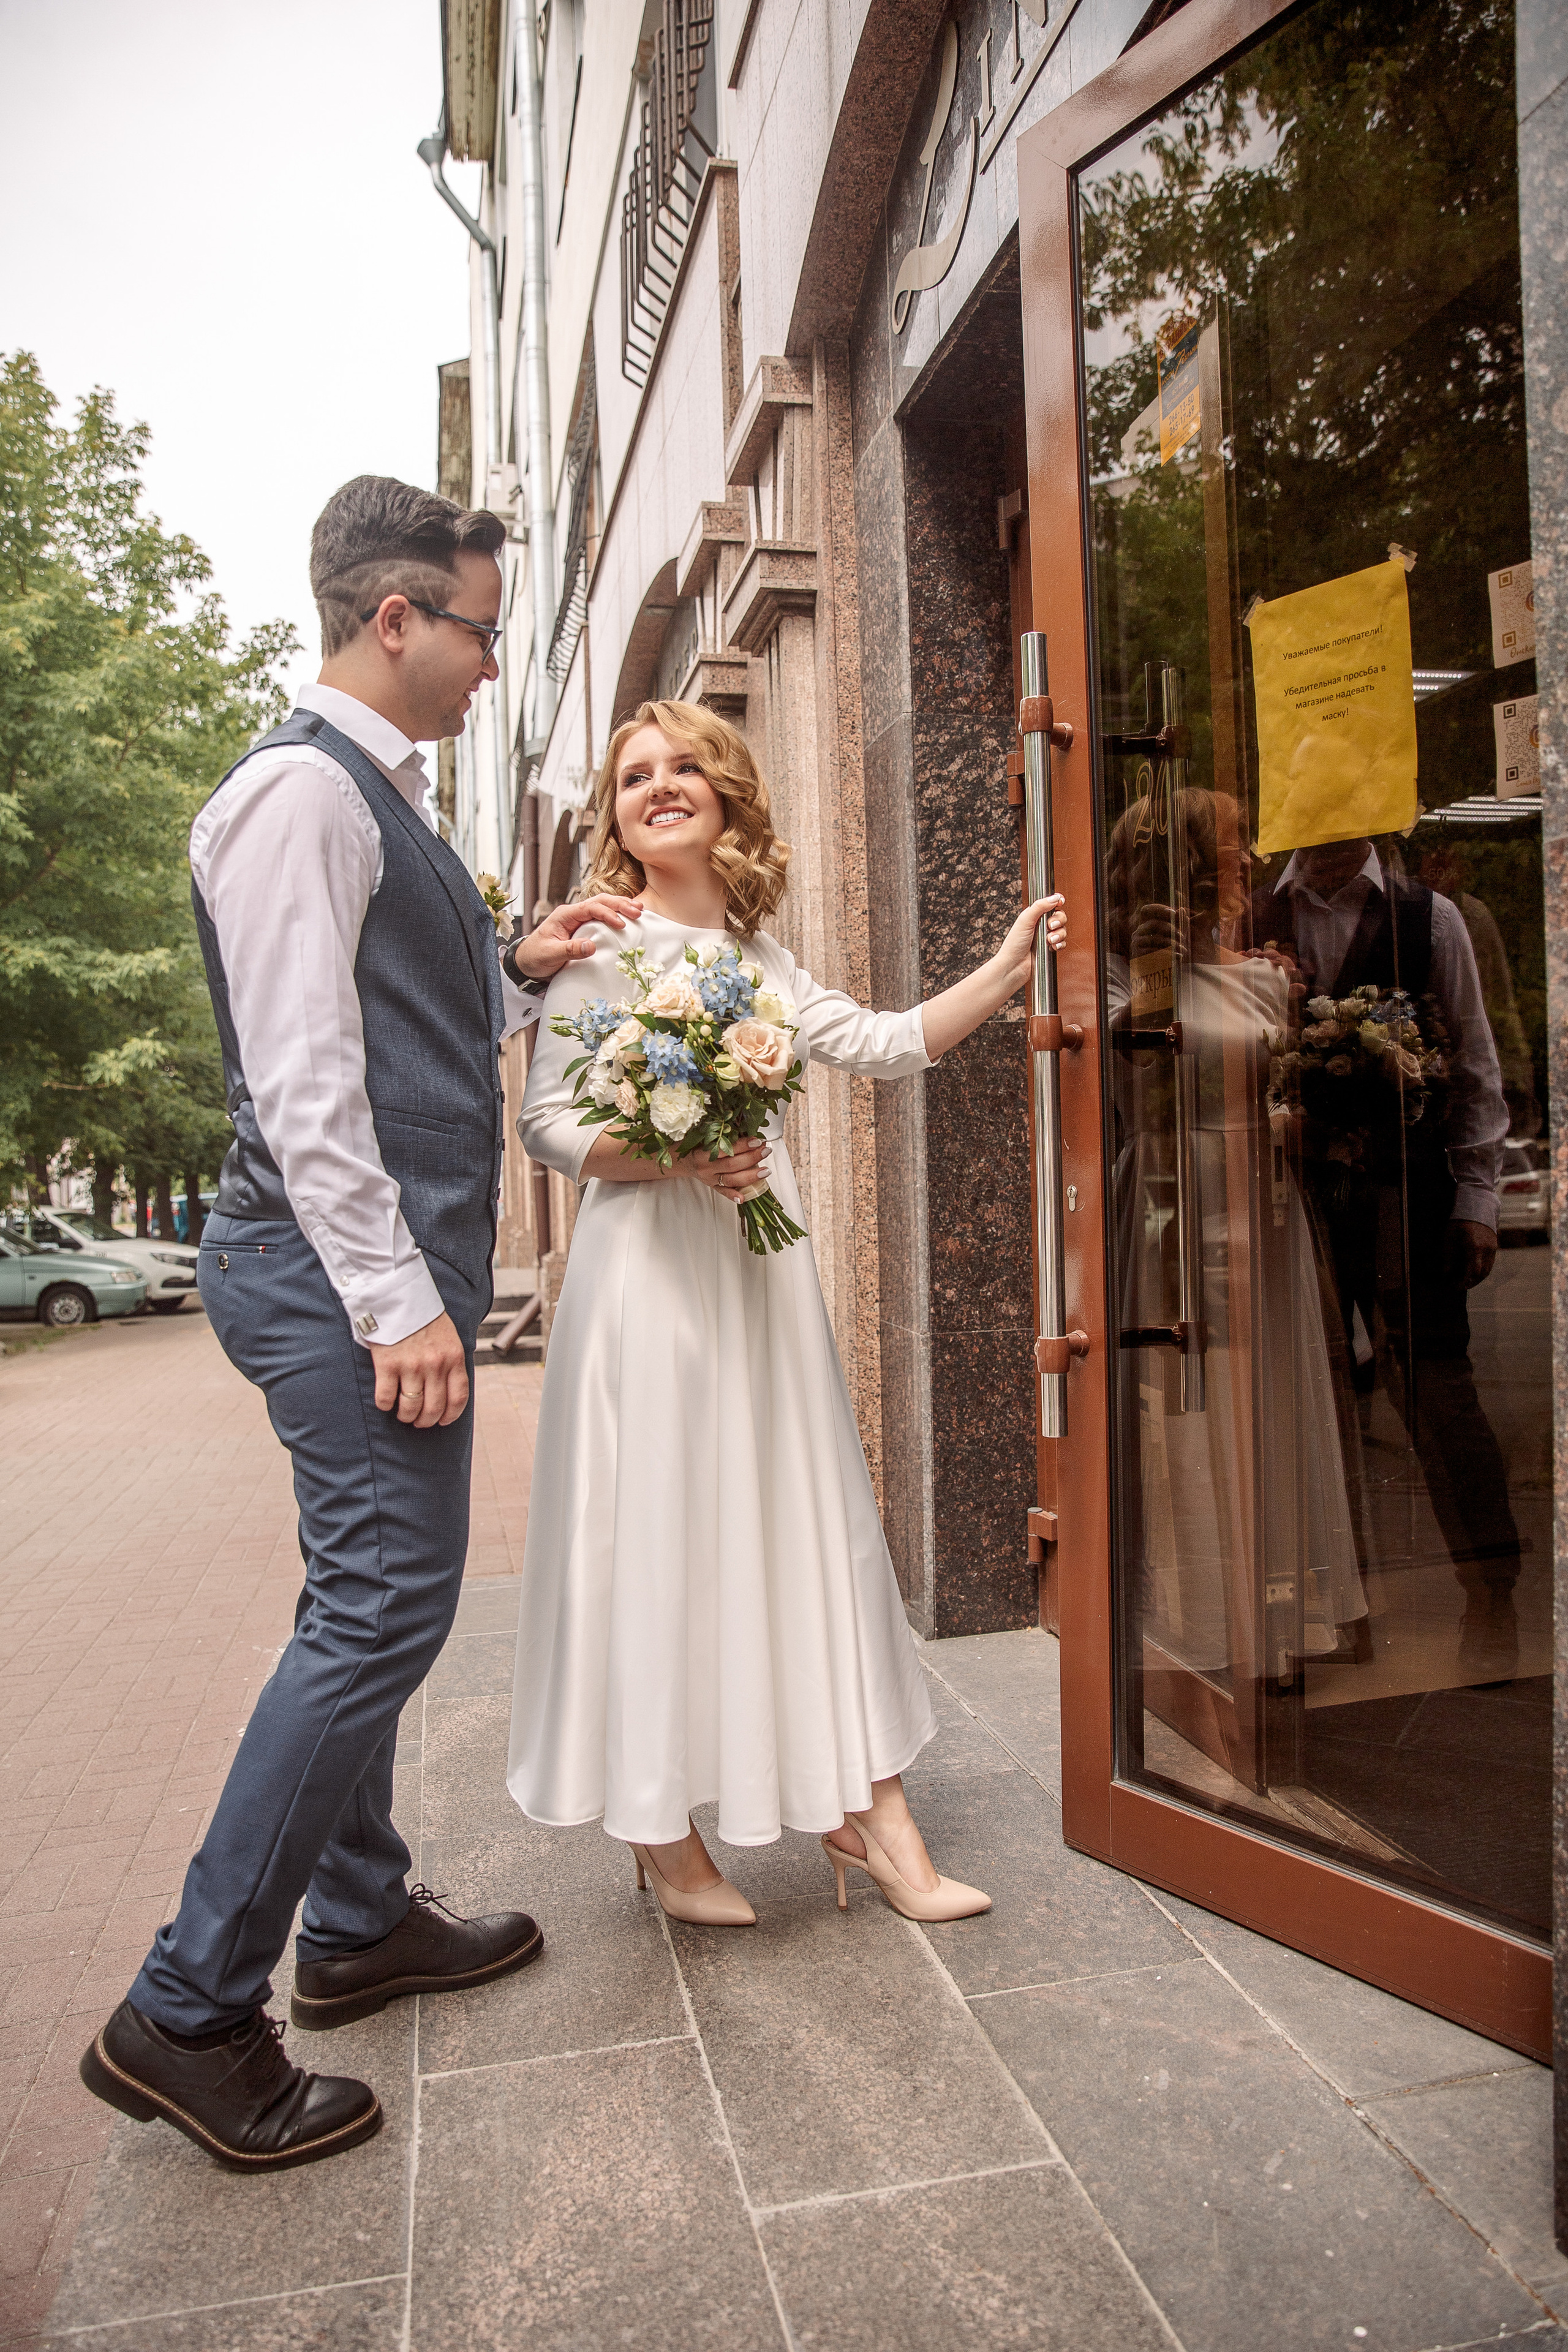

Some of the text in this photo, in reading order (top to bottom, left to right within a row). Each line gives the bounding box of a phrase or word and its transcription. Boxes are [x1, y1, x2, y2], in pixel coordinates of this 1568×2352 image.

[1169, 393, 1194, 426] 266-13-50
[1169, 405, 1194, 437] 265-17-69
[1283, 624, 1383, 660] Уважаемые покупатели!
[1284, 677, 1341, 696] Убедительная
[1343, 666, 1379, 682] просьба
[1295, 684, 1374, 709] магазине надевать
[1322, 707, 1349, 722] маску!
